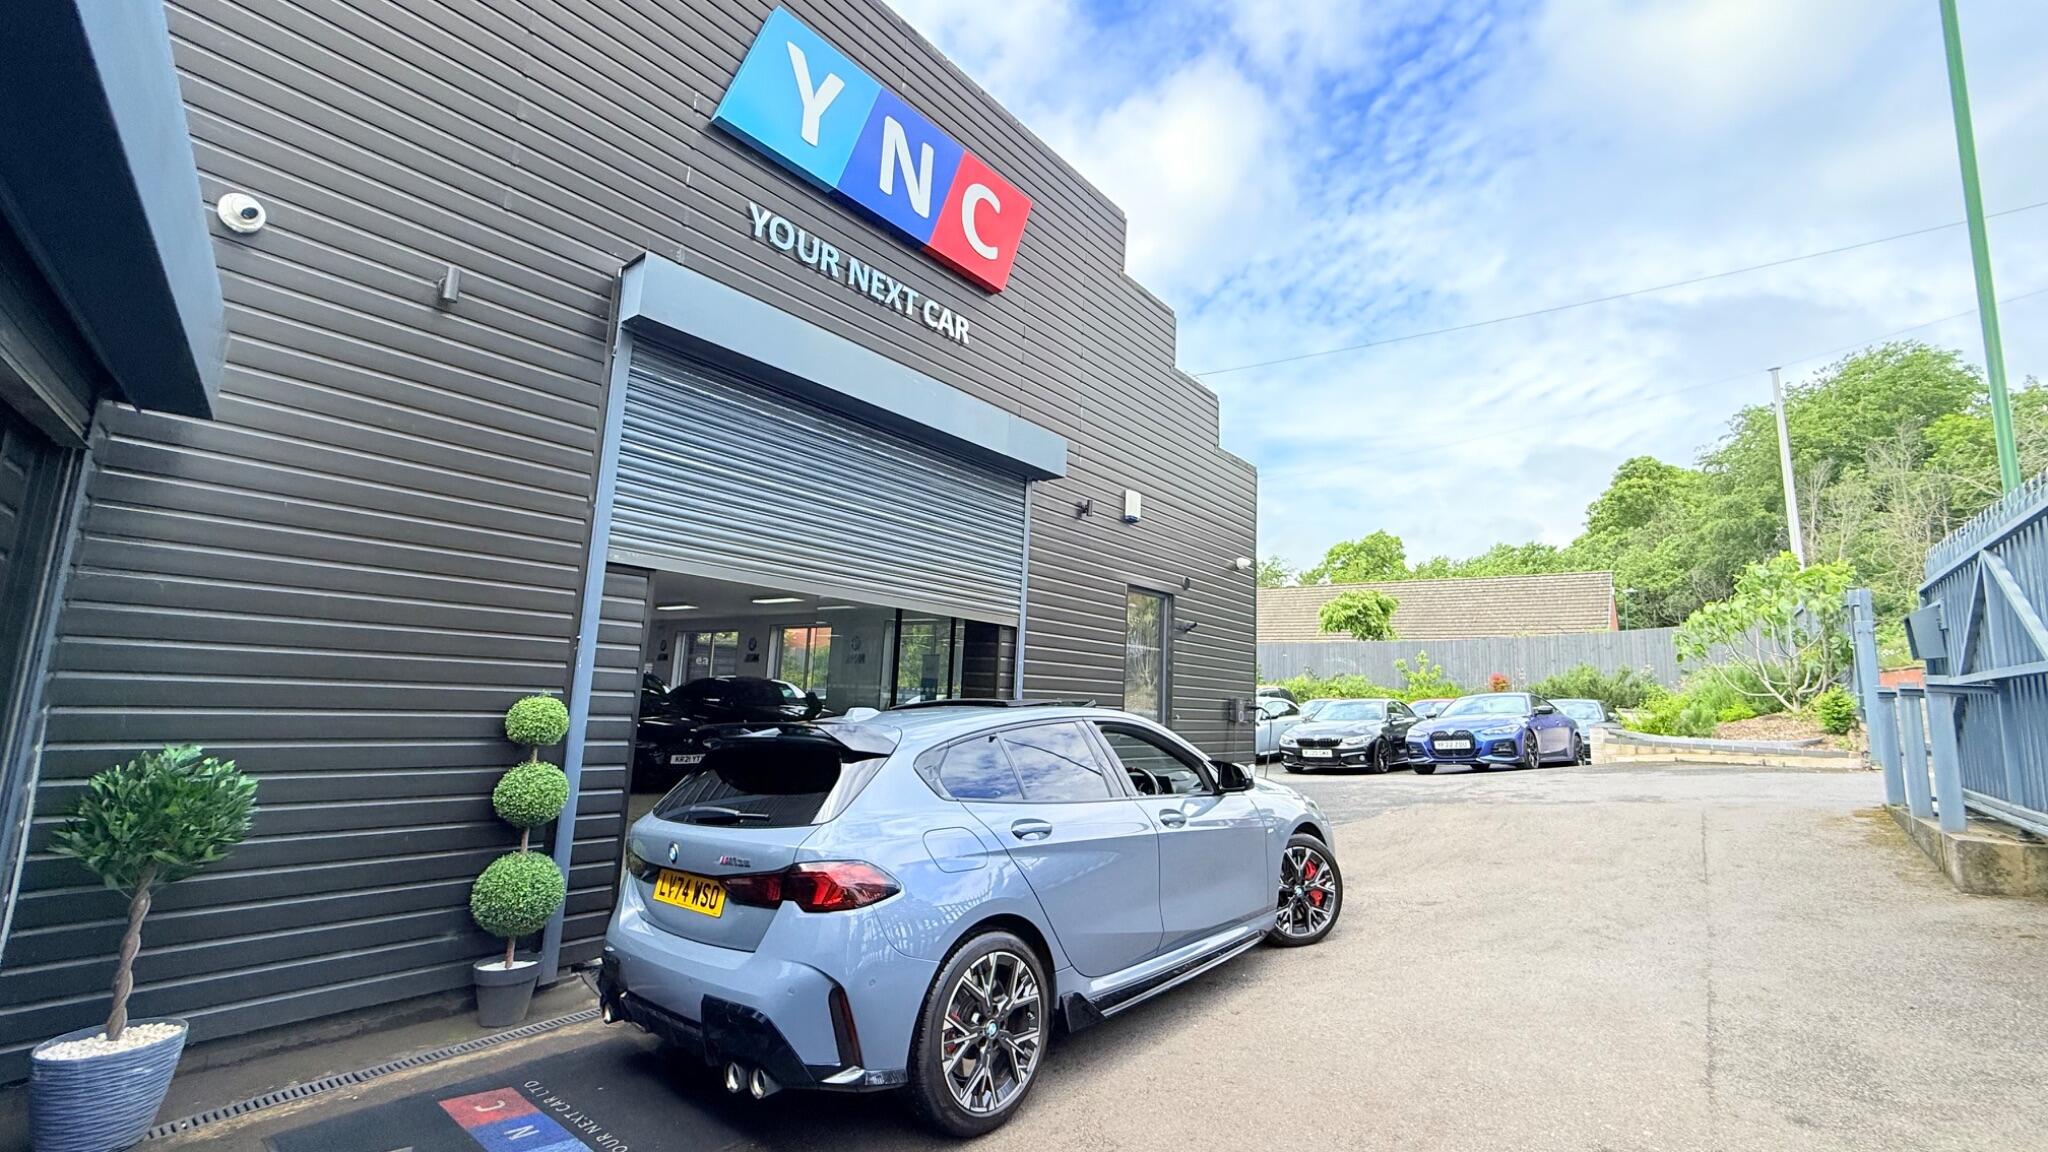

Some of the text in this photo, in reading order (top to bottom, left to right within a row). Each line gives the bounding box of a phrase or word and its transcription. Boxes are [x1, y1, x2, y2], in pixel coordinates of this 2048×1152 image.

[787, 40, 1001, 261] YNC
[749, 201, 970, 345] YOUR NEXT CAR
[474, 1100, 540, 1141] NC
[523, 1080, 628, 1152] OUR NEXT CAR LTD
